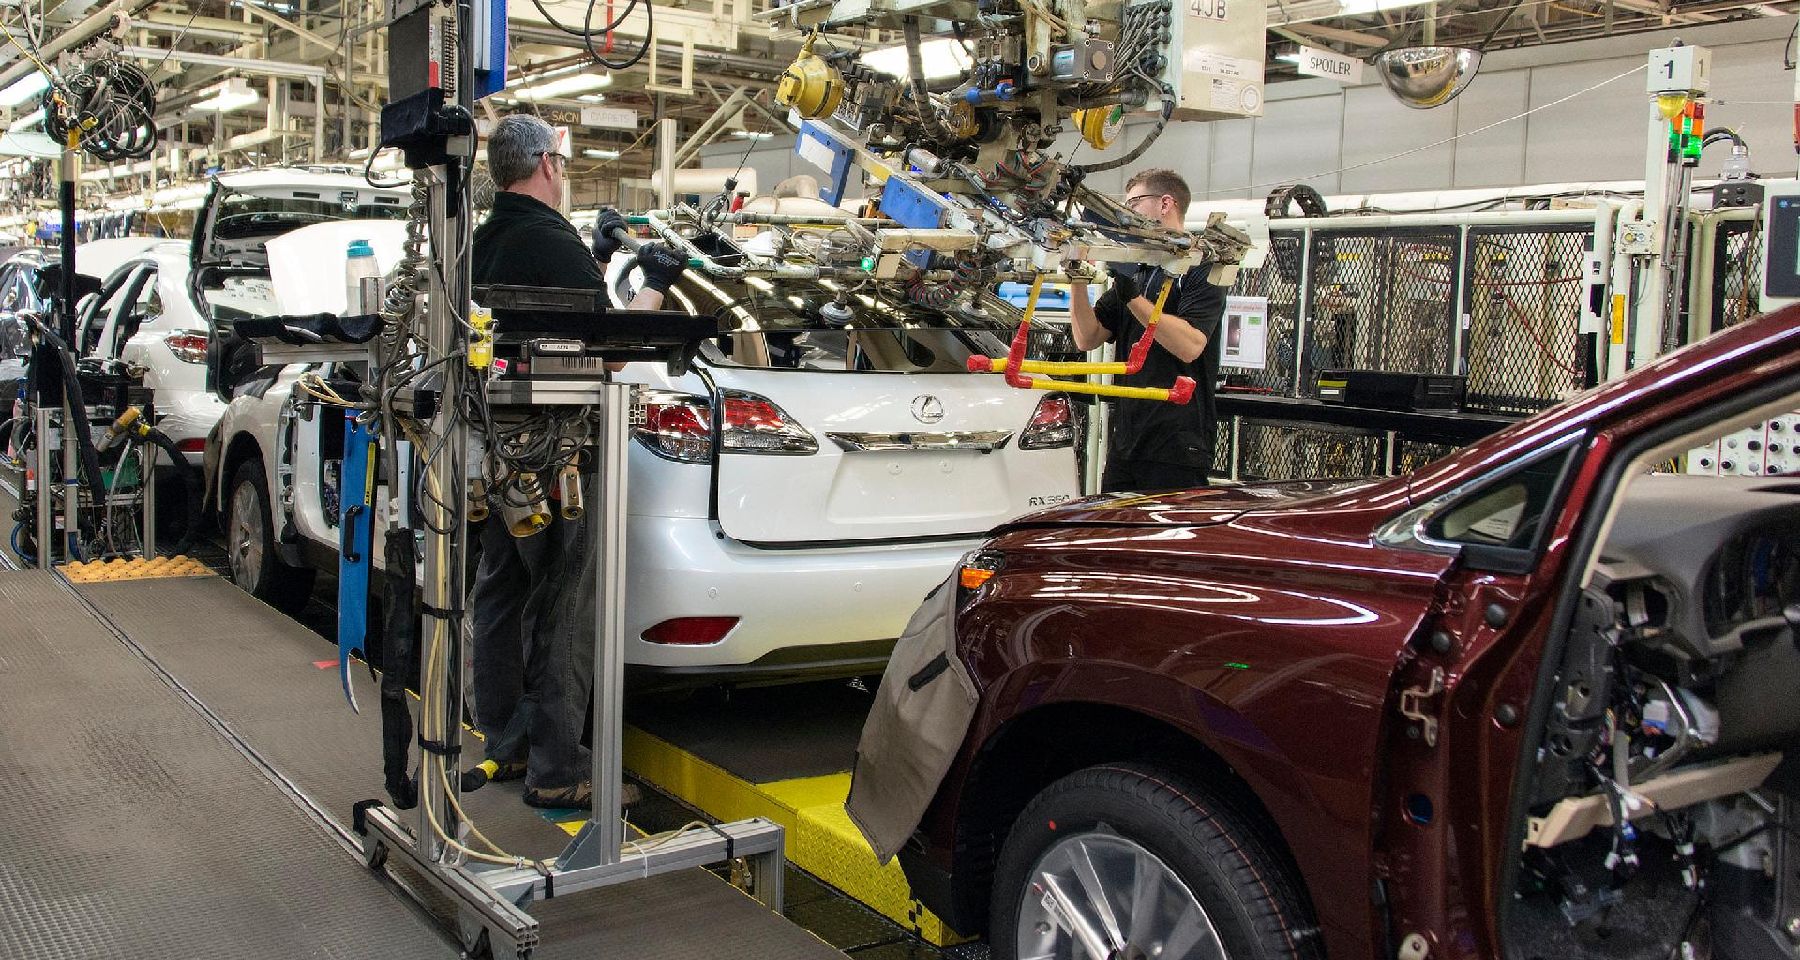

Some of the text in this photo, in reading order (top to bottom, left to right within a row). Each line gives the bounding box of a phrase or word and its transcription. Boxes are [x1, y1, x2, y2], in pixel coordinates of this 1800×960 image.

[1191, 0, 1226, 18] 4JB
[1310, 58, 1351, 76] SPOILER
[1664, 60, 1674, 79] 1
[1698, 58, 1704, 77] 1
